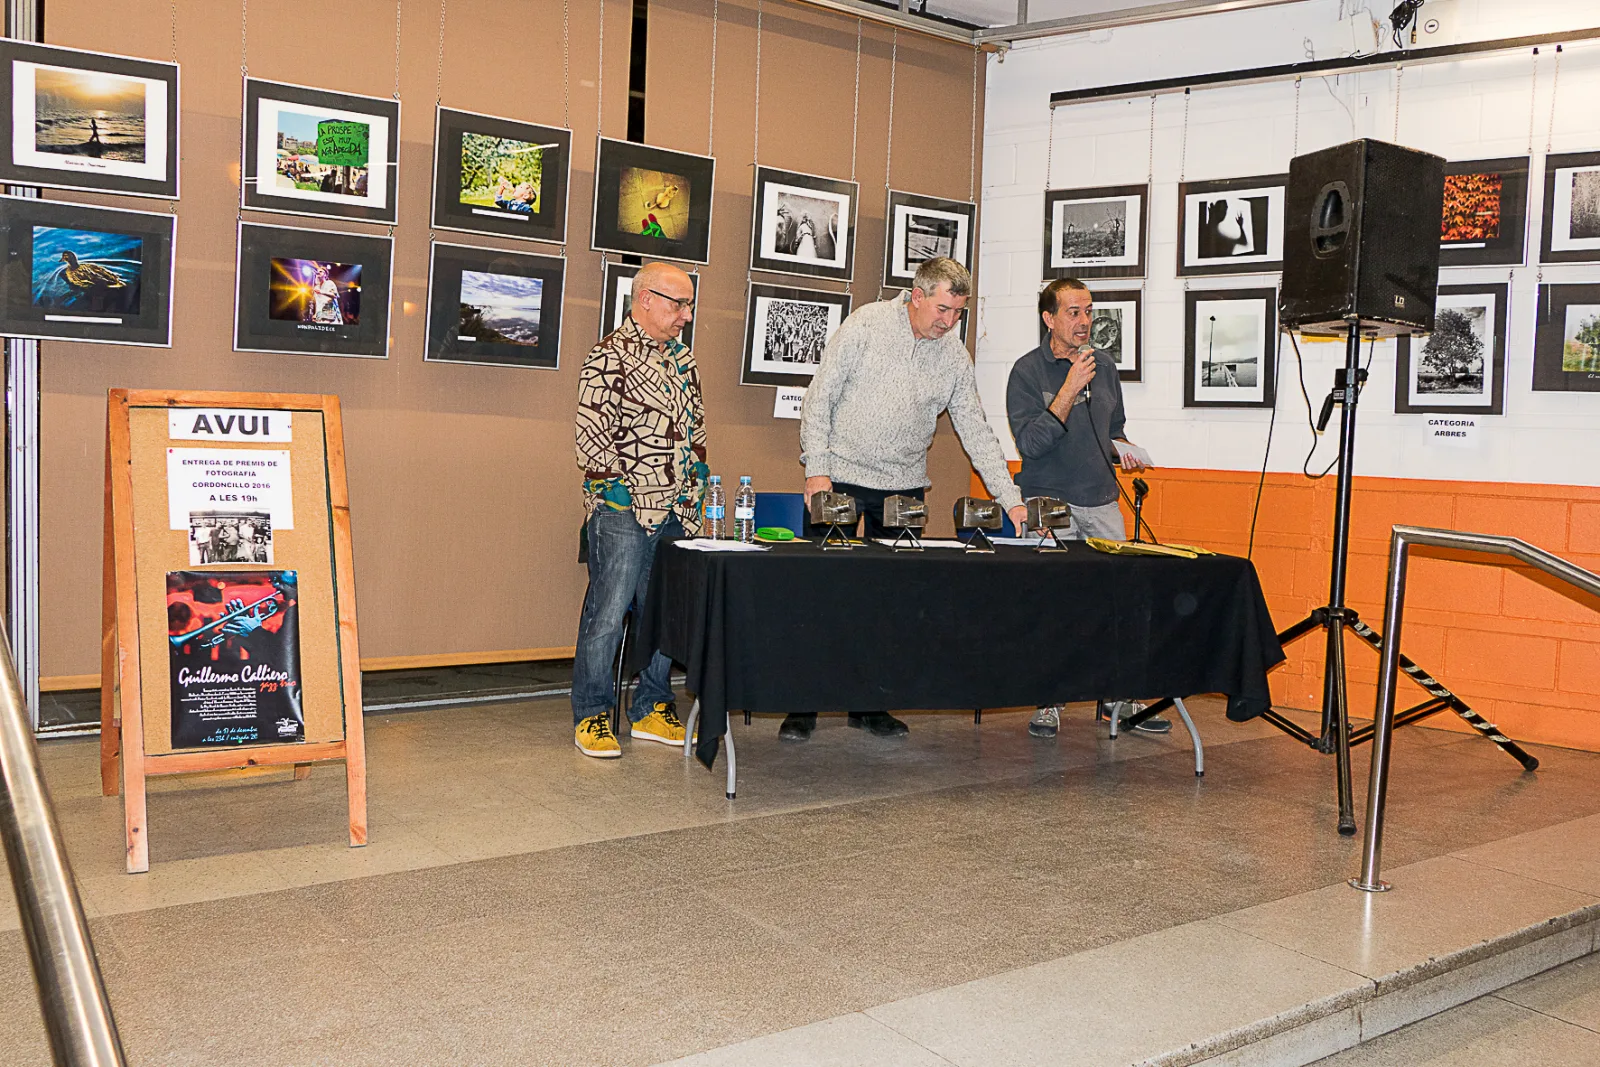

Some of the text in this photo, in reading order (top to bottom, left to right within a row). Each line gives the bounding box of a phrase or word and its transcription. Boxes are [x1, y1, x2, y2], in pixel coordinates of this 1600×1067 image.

[191, 414, 270, 436] AVUI
[1428, 419, 1475, 427] CATEGORIA
[192, 481, 250, 489] CORDONCILLO
[219, 494, 238, 502] LES
[178, 666, 239, 688] Guillermo
